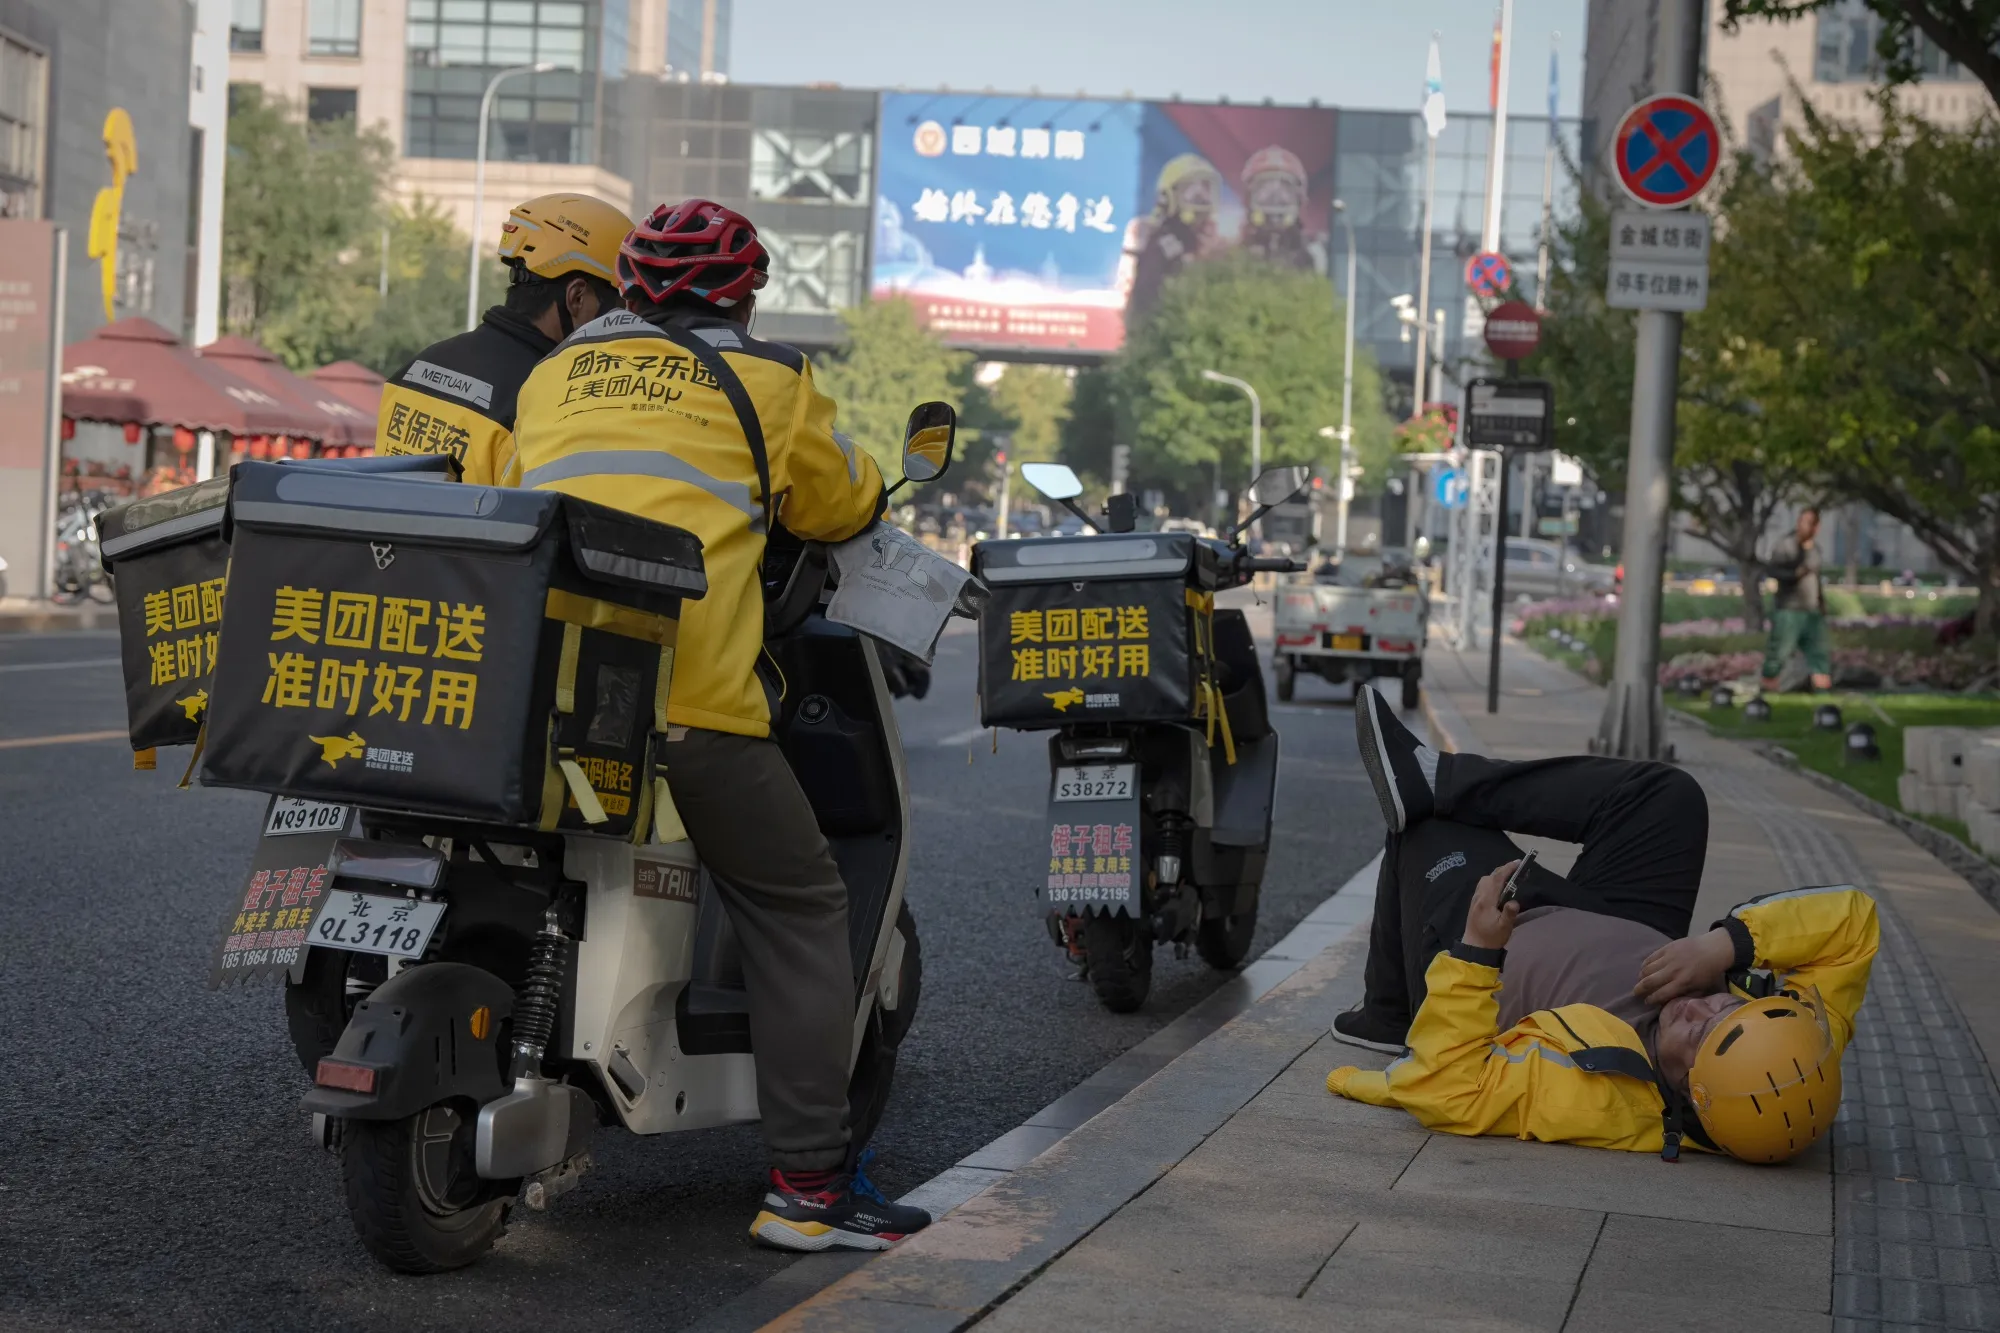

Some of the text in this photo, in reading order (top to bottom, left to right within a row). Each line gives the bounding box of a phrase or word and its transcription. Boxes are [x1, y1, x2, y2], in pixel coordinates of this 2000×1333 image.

[1619, 223, 1702, 249] 金城坊街
[603, 314, 645, 328] MEI
[421, 368, 472, 394] MEITUAN
[557, 374, 683, 409] 上美团App
[386, 401, 470, 465] 医保买药
[269, 585, 486, 662] 美团配送
[1009, 605, 1150, 645] 美团配送
[1010, 644, 1150, 682] 准时好用
[261, 651, 478, 730] 准时好用
[365, 747, 414, 766] 美团配送
[1060, 781, 1128, 798] S38272
[271, 806, 341, 832] NQ9108
[1050, 822, 1133, 857] 橙子租车
[1049, 856, 1131, 874] 外卖车 家用车
[1048, 887, 1130, 901] 130 2194 2195
[231, 906, 313, 934] 外卖车 家用车
[348, 900, 409, 923] 北京
[318, 917, 421, 951] QL3118
[221, 947, 300, 970] 185 1864 1865
